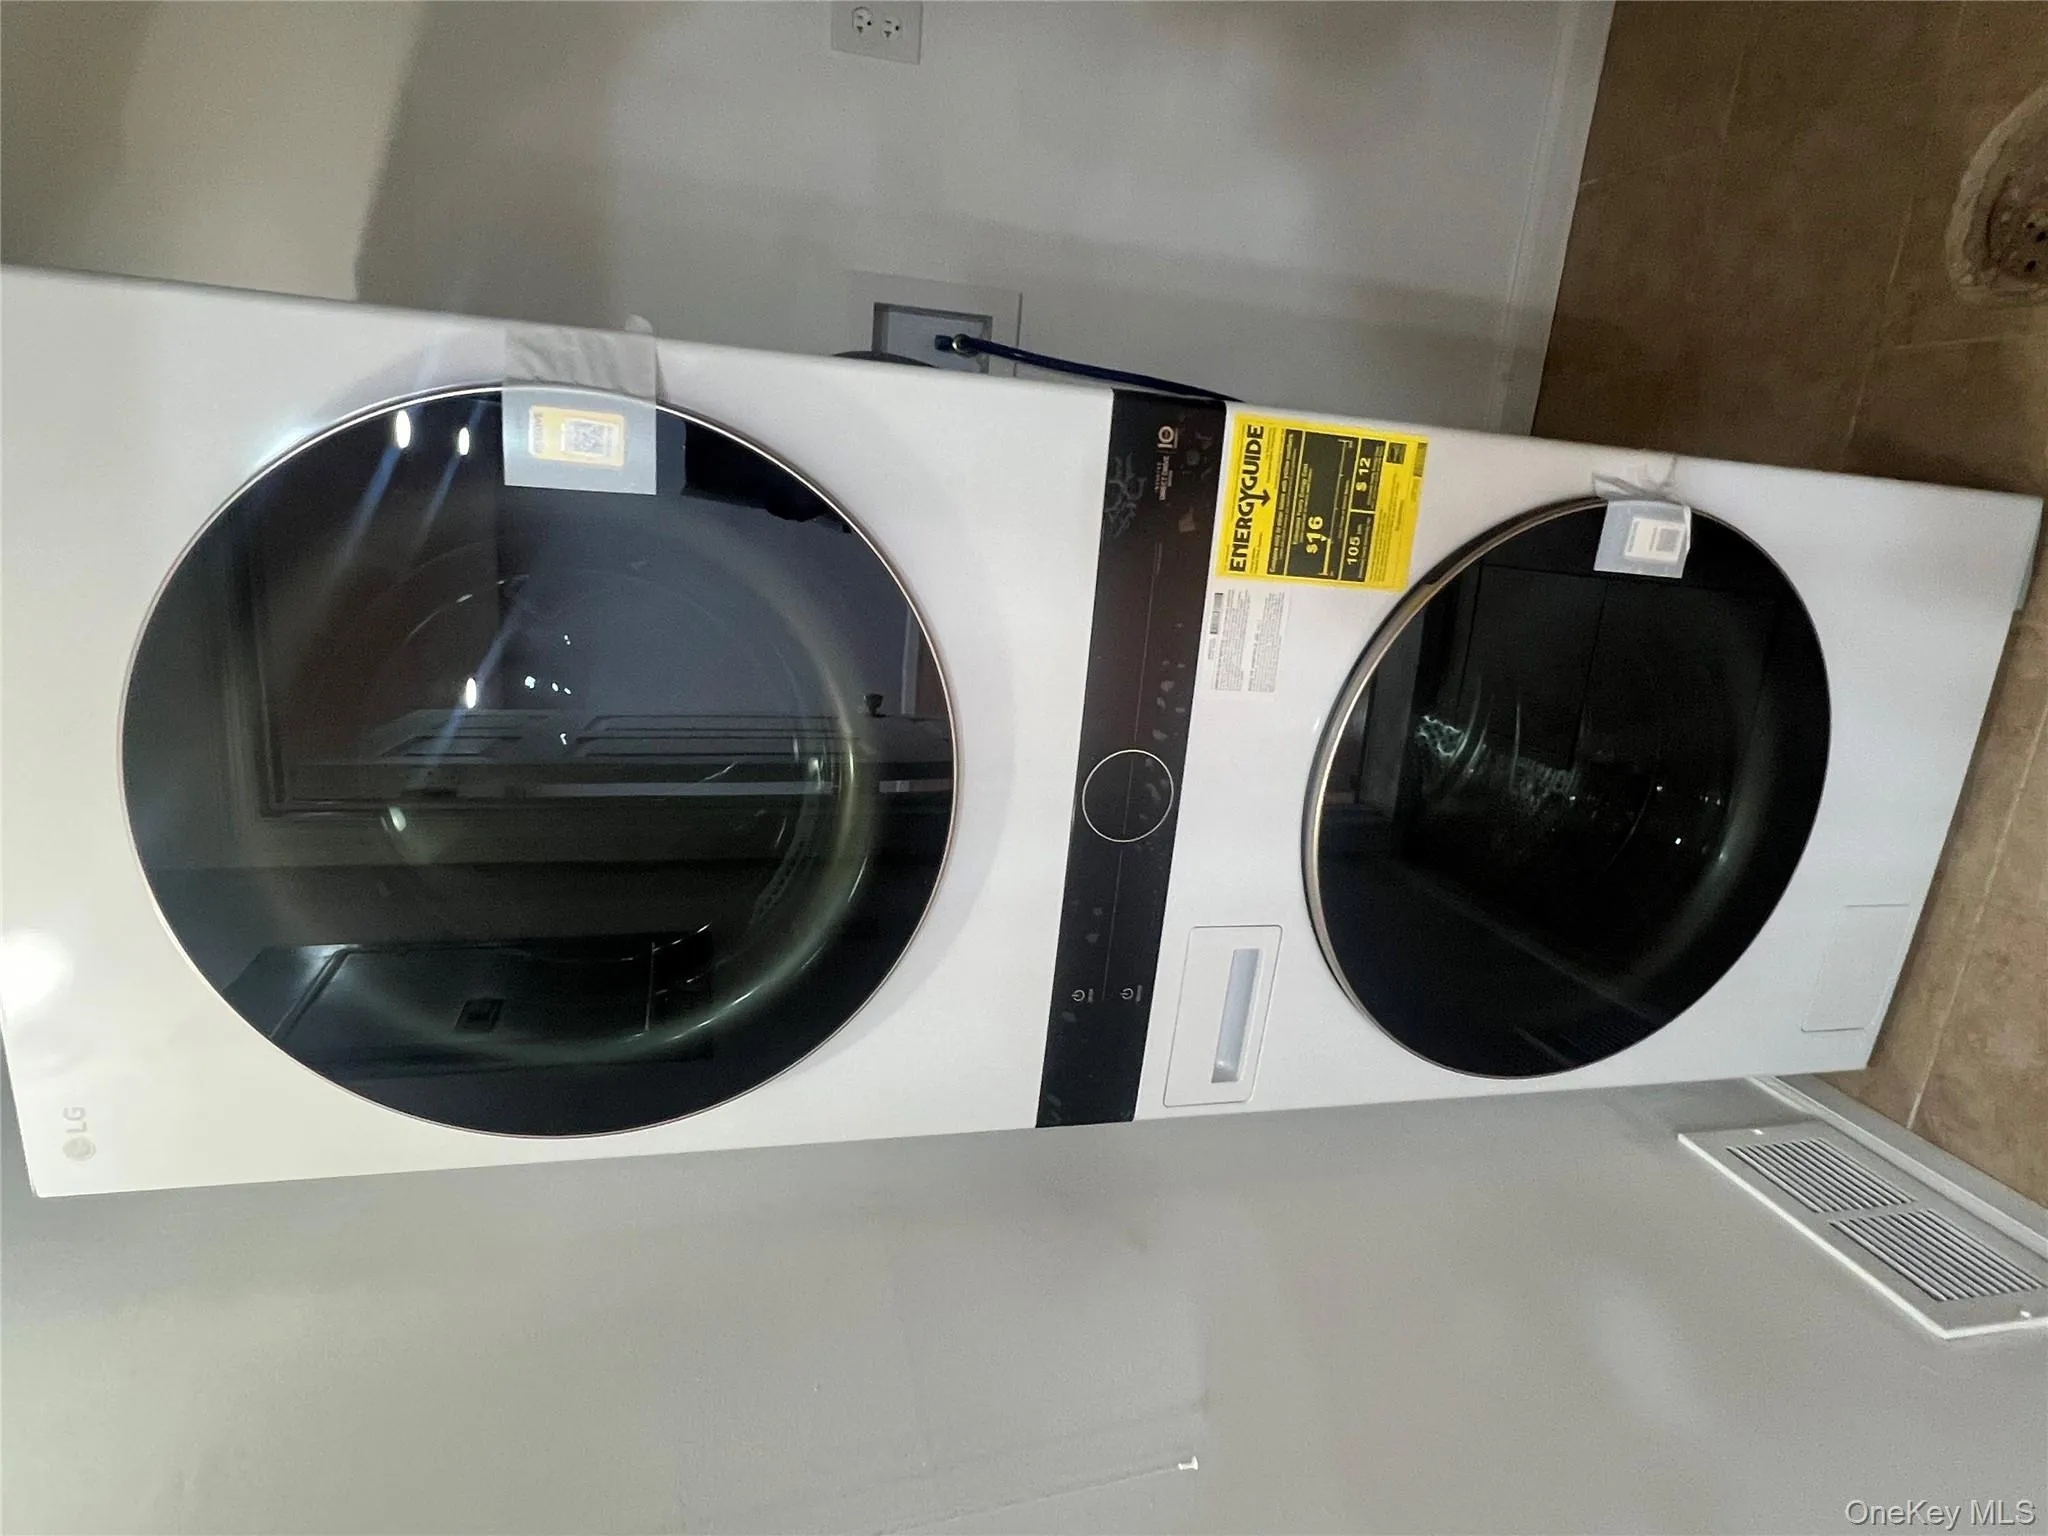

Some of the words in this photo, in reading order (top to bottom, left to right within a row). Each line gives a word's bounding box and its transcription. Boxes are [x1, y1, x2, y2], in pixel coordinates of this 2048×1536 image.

[1358, 458, 1370, 475] 12
[1229, 425, 1264, 573] ENERGYGUIDE
[1346, 537, 1360, 565] 105
[63, 1107, 87, 1133] LG
